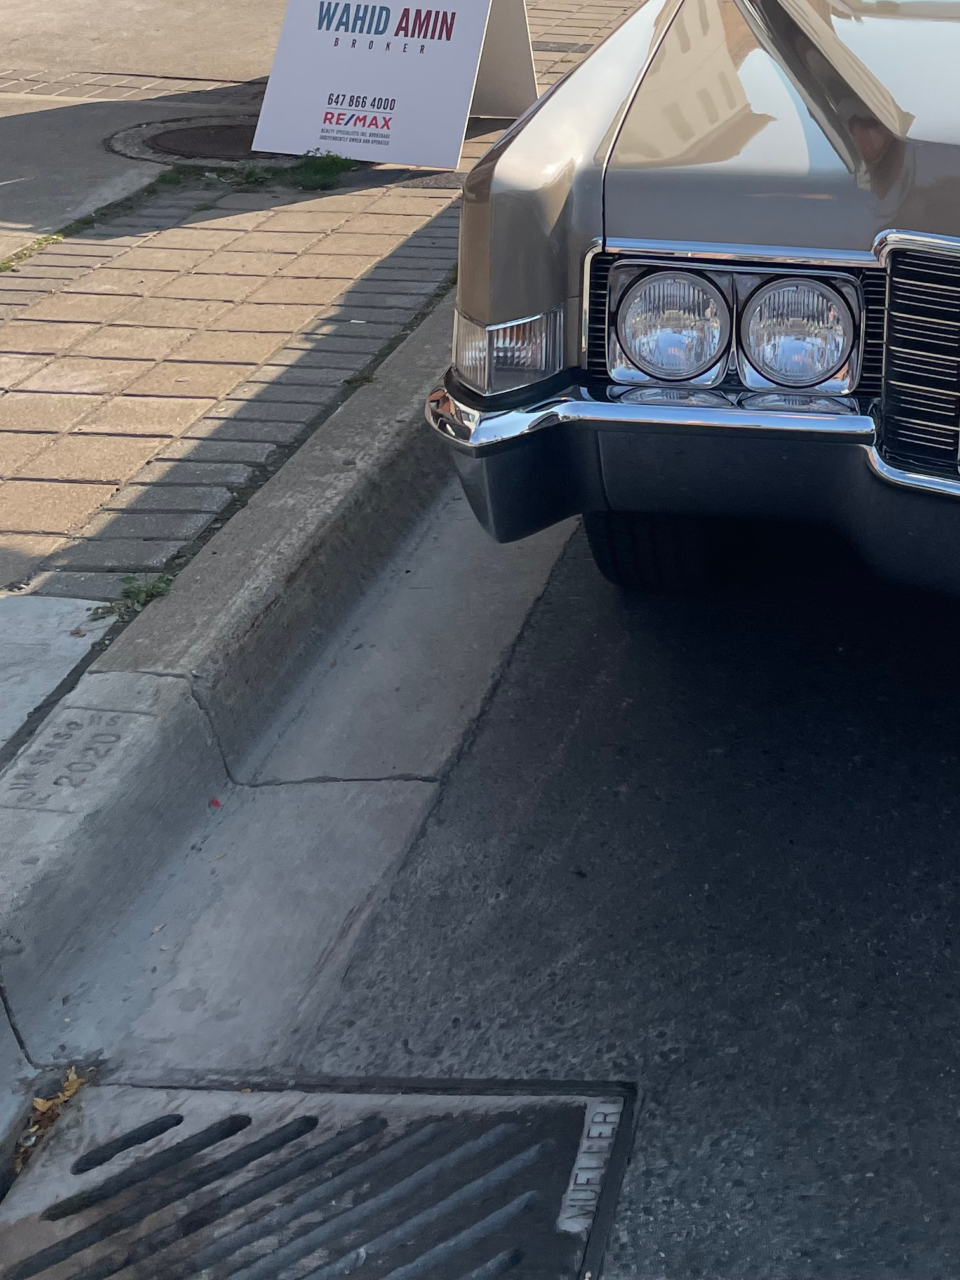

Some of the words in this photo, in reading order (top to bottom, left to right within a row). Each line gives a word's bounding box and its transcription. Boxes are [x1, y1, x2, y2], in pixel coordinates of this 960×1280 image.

[317, 0, 391, 36] WAHID
[393, 7, 457, 41] AMIN
[333, 37, 426, 54] BROKER
[327, 93, 346, 107] 647
[348, 95, 367, 109] 866
[370, 96, 396, 111] 4000
[323, 112, 393, 130] RE/MAX
[53, 733, 121, 788] 2020
